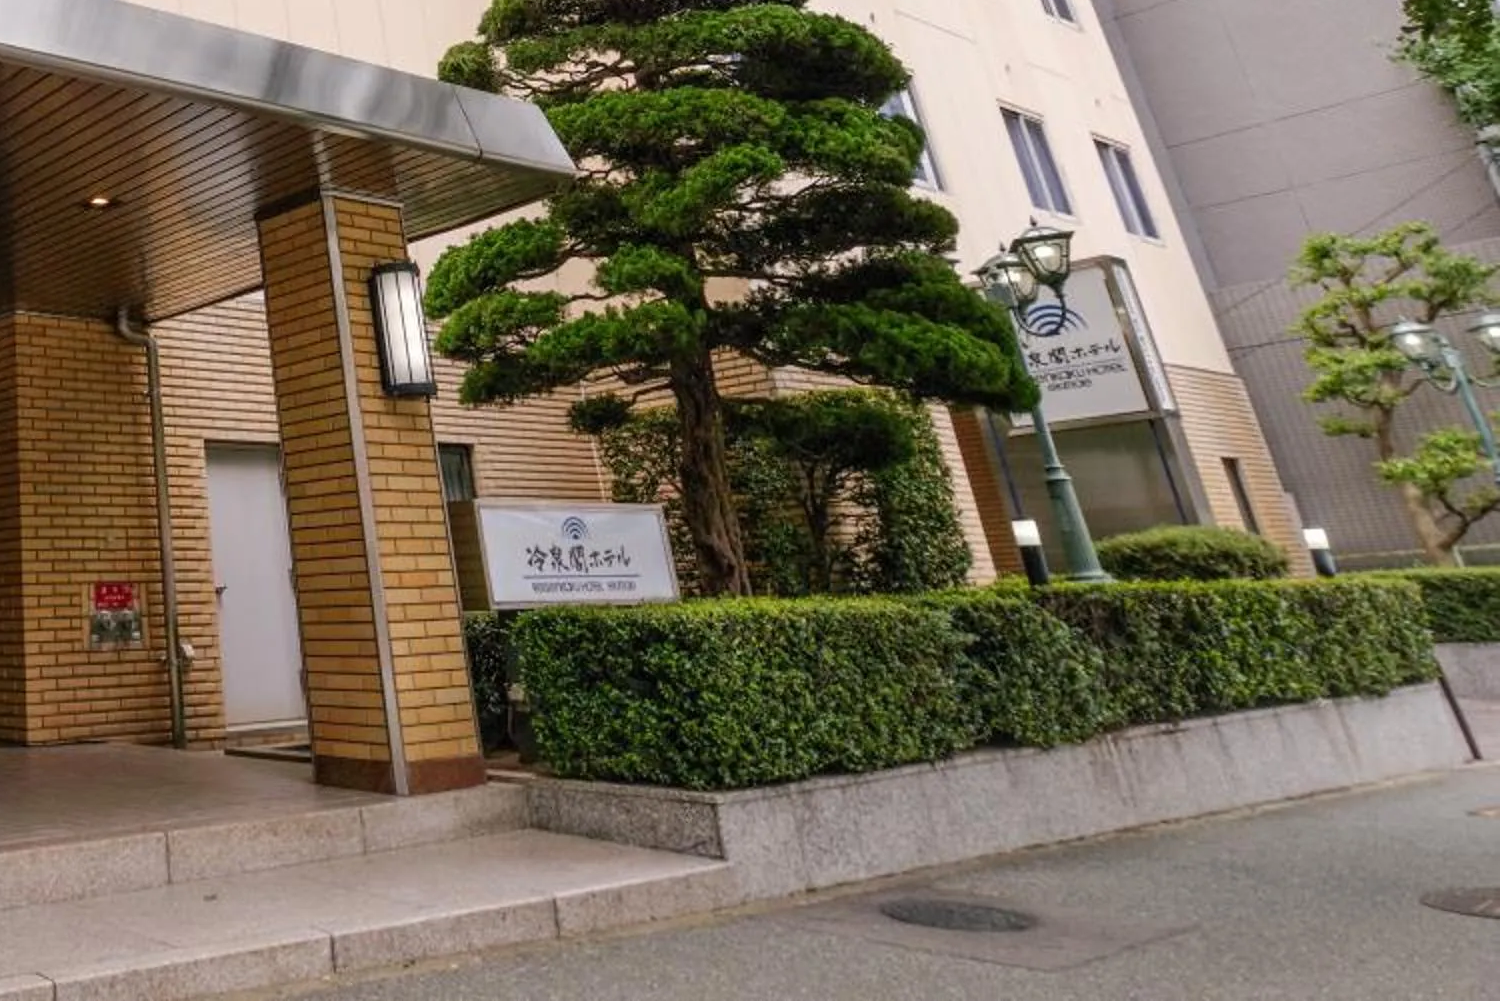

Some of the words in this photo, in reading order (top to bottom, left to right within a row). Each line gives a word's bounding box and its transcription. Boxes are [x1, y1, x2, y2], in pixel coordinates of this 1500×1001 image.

[1021, 339, 1121, 368] 泉閣ホテル
[525, 544, 631, 573] 冷泉閣ホテル
